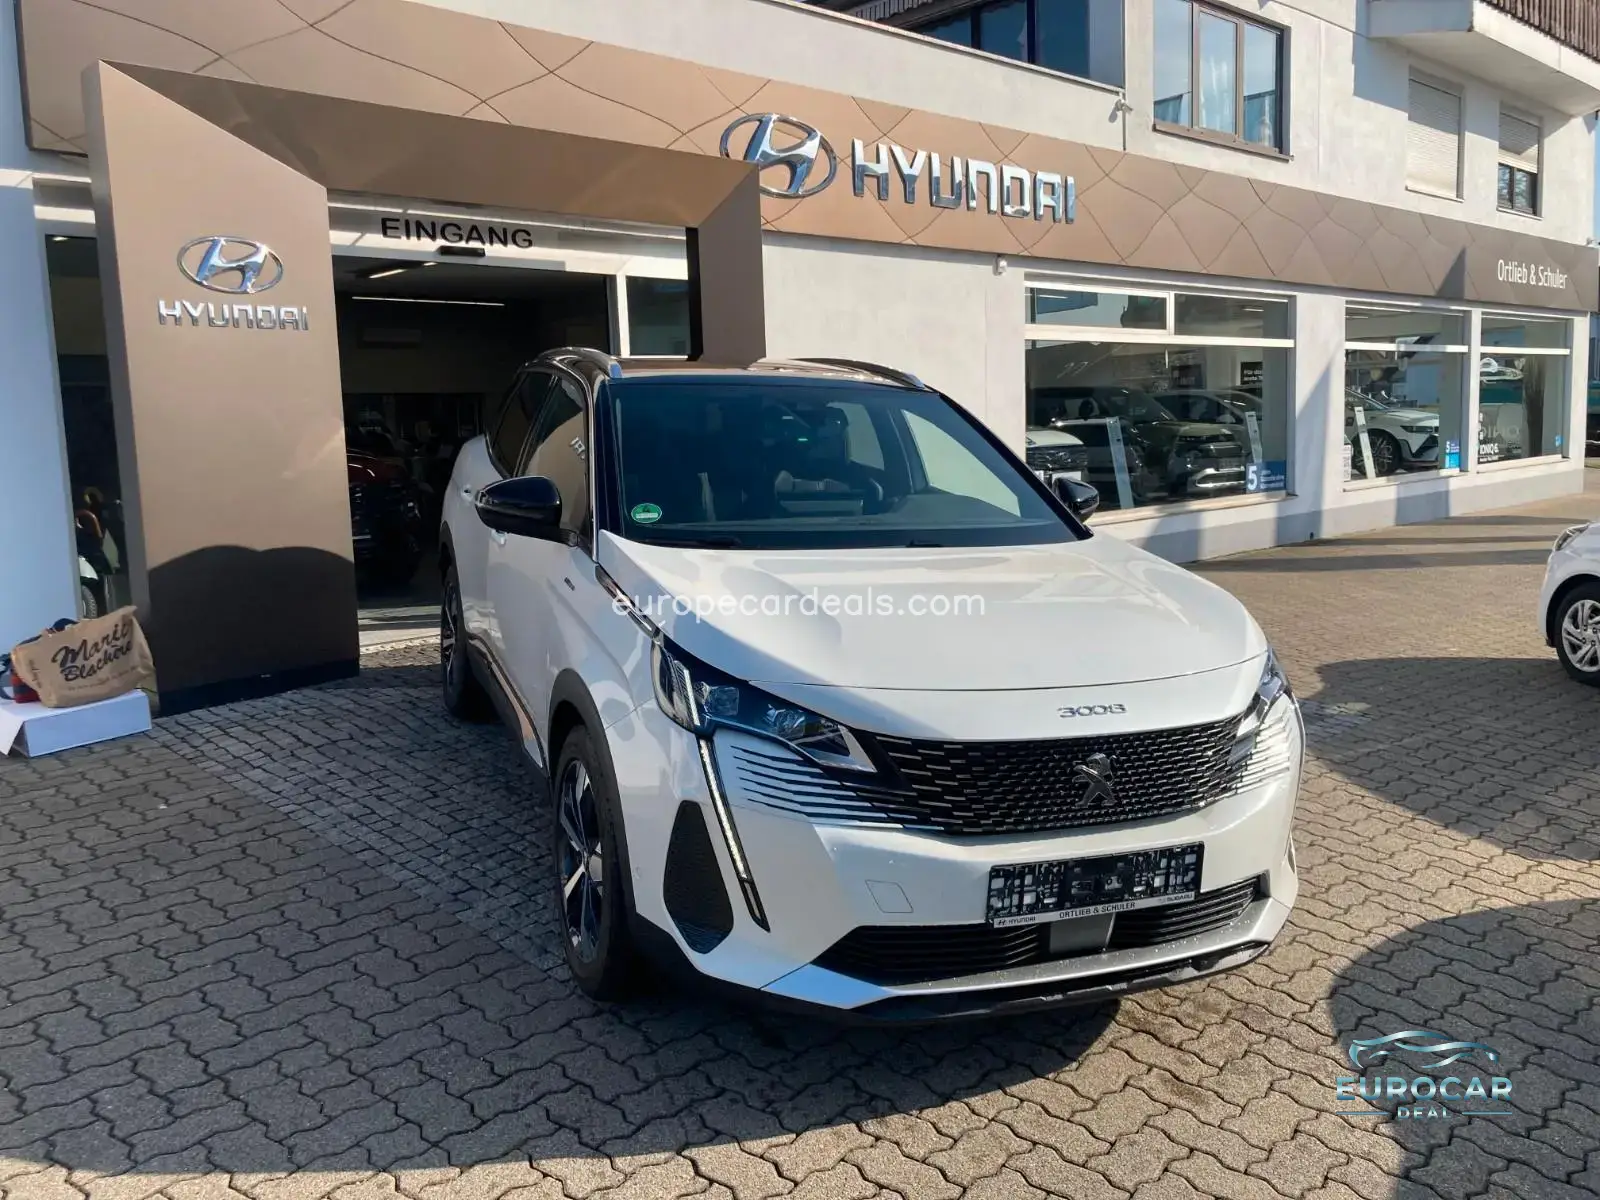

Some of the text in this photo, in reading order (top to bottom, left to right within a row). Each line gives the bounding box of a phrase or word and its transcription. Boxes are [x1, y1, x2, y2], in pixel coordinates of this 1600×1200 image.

[852, 137, 1075, 224] HYUNDAI
[381, 217, 533, 248] EINGANG
[1498, 259, 1567, 289] Ortlieb & Schuler
[158, 299, 309, 331] HYUNDAI
[1248, 465, 1257, 490] 5
[1058, 703, 1127, 718] 3008
[1060, 908, 1091, 919] ORTLIEB
[1093, 906, 1099, 914] &
[1101, 902, 1136, 913] SCHULER
